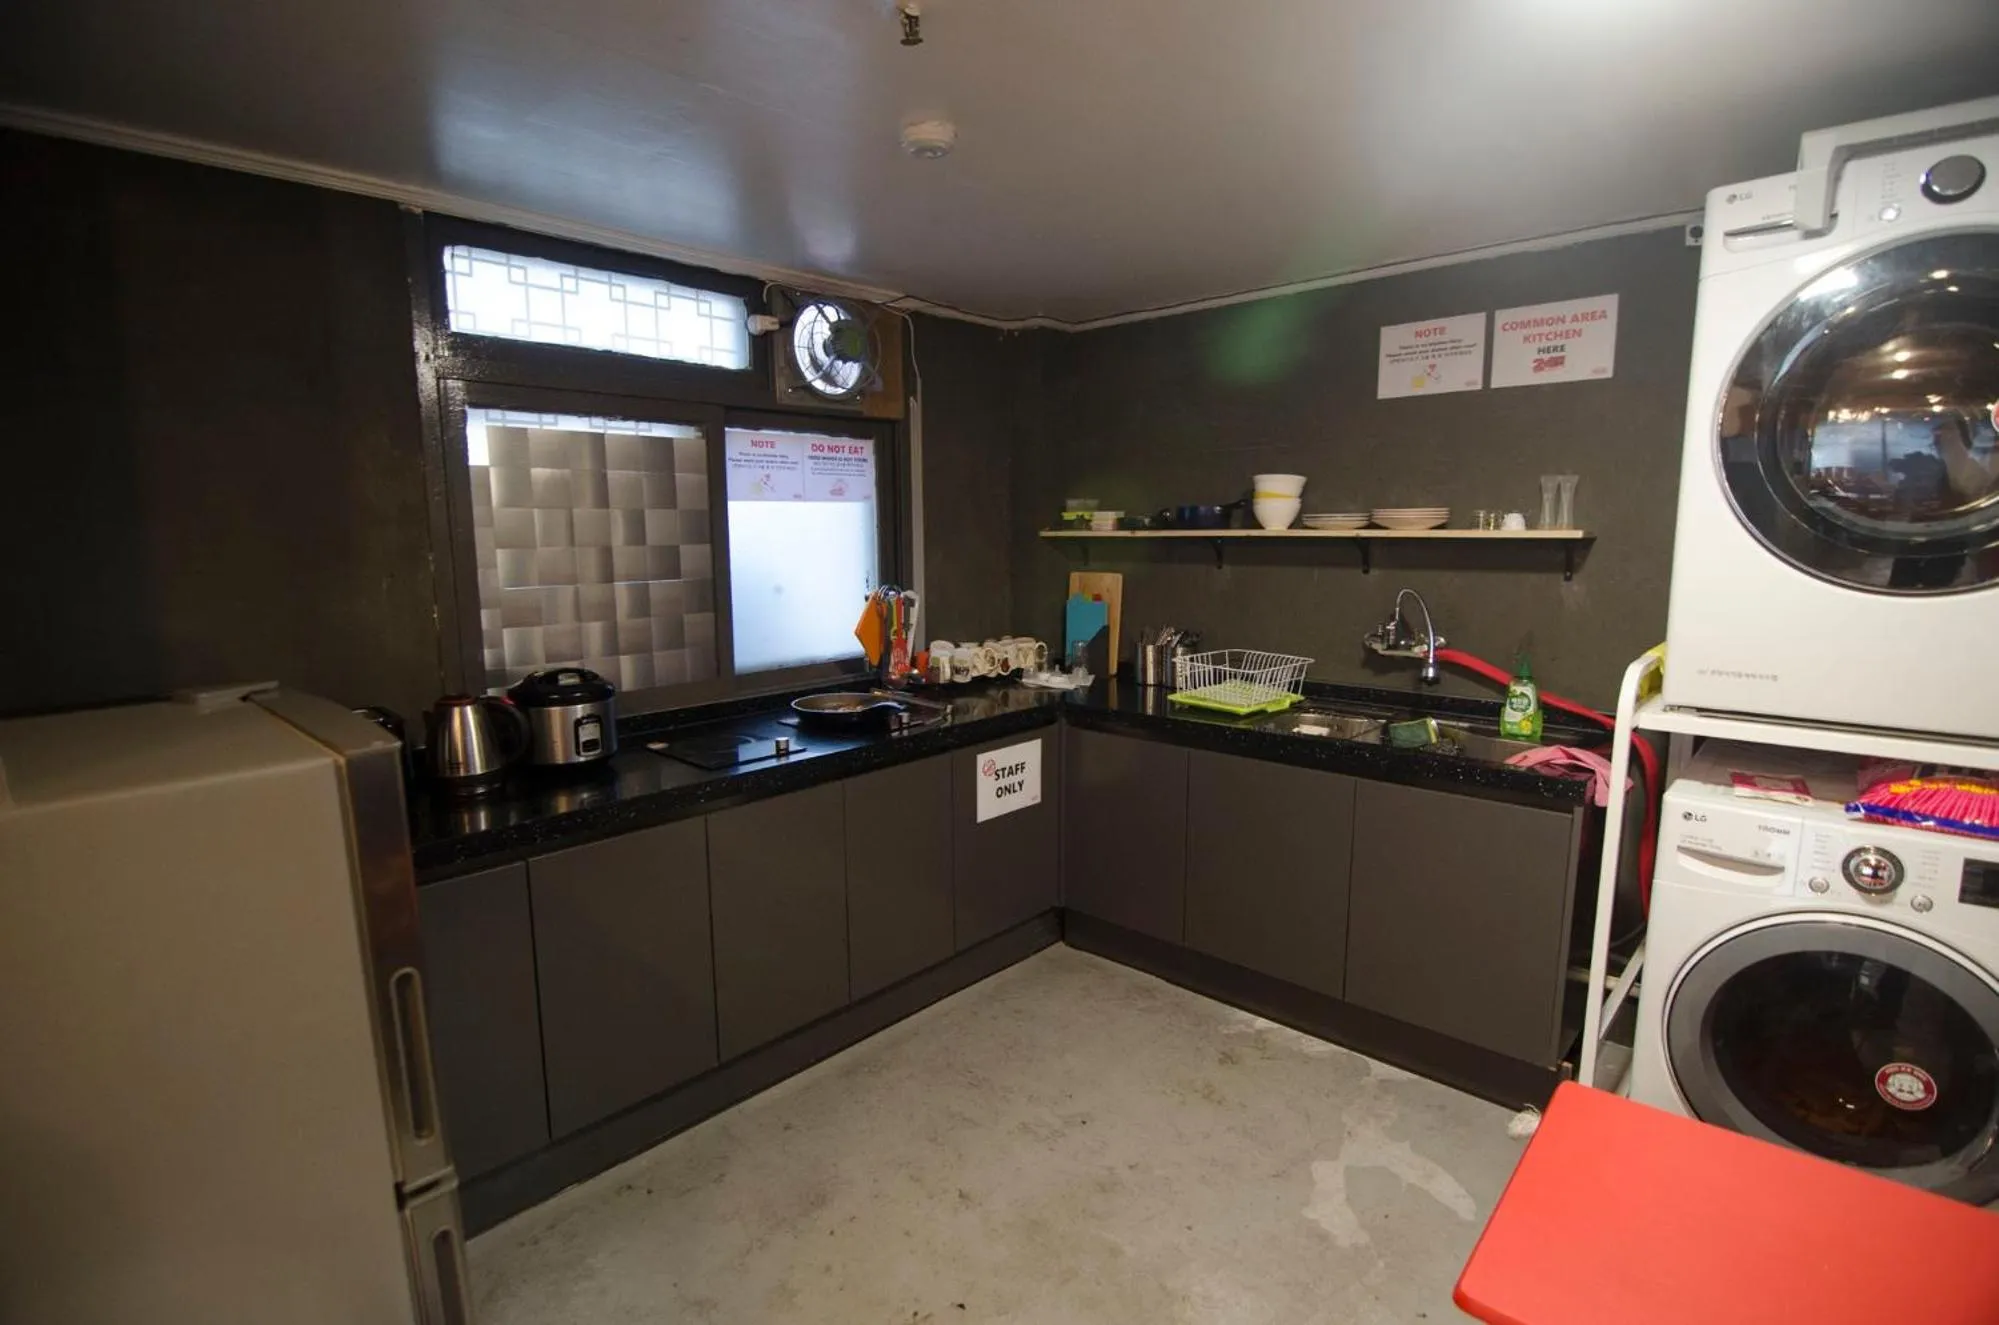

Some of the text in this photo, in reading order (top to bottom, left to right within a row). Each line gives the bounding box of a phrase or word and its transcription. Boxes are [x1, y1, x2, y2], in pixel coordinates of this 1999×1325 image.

[1501, 309, 1608, 332] COMMON AREA
[1415, 326, 1447, 339] NOTE
[1522, 328, 1583, 345] KITCHEN
[1537, 344, 1566, 355] HERE
[751, 439, 776, 449] NOTE
[811, 443, 865, 456] DO NOT EAT
[995, 761, 1026, 781] STAFF
[995, 780, 1025, 798] ONLY
